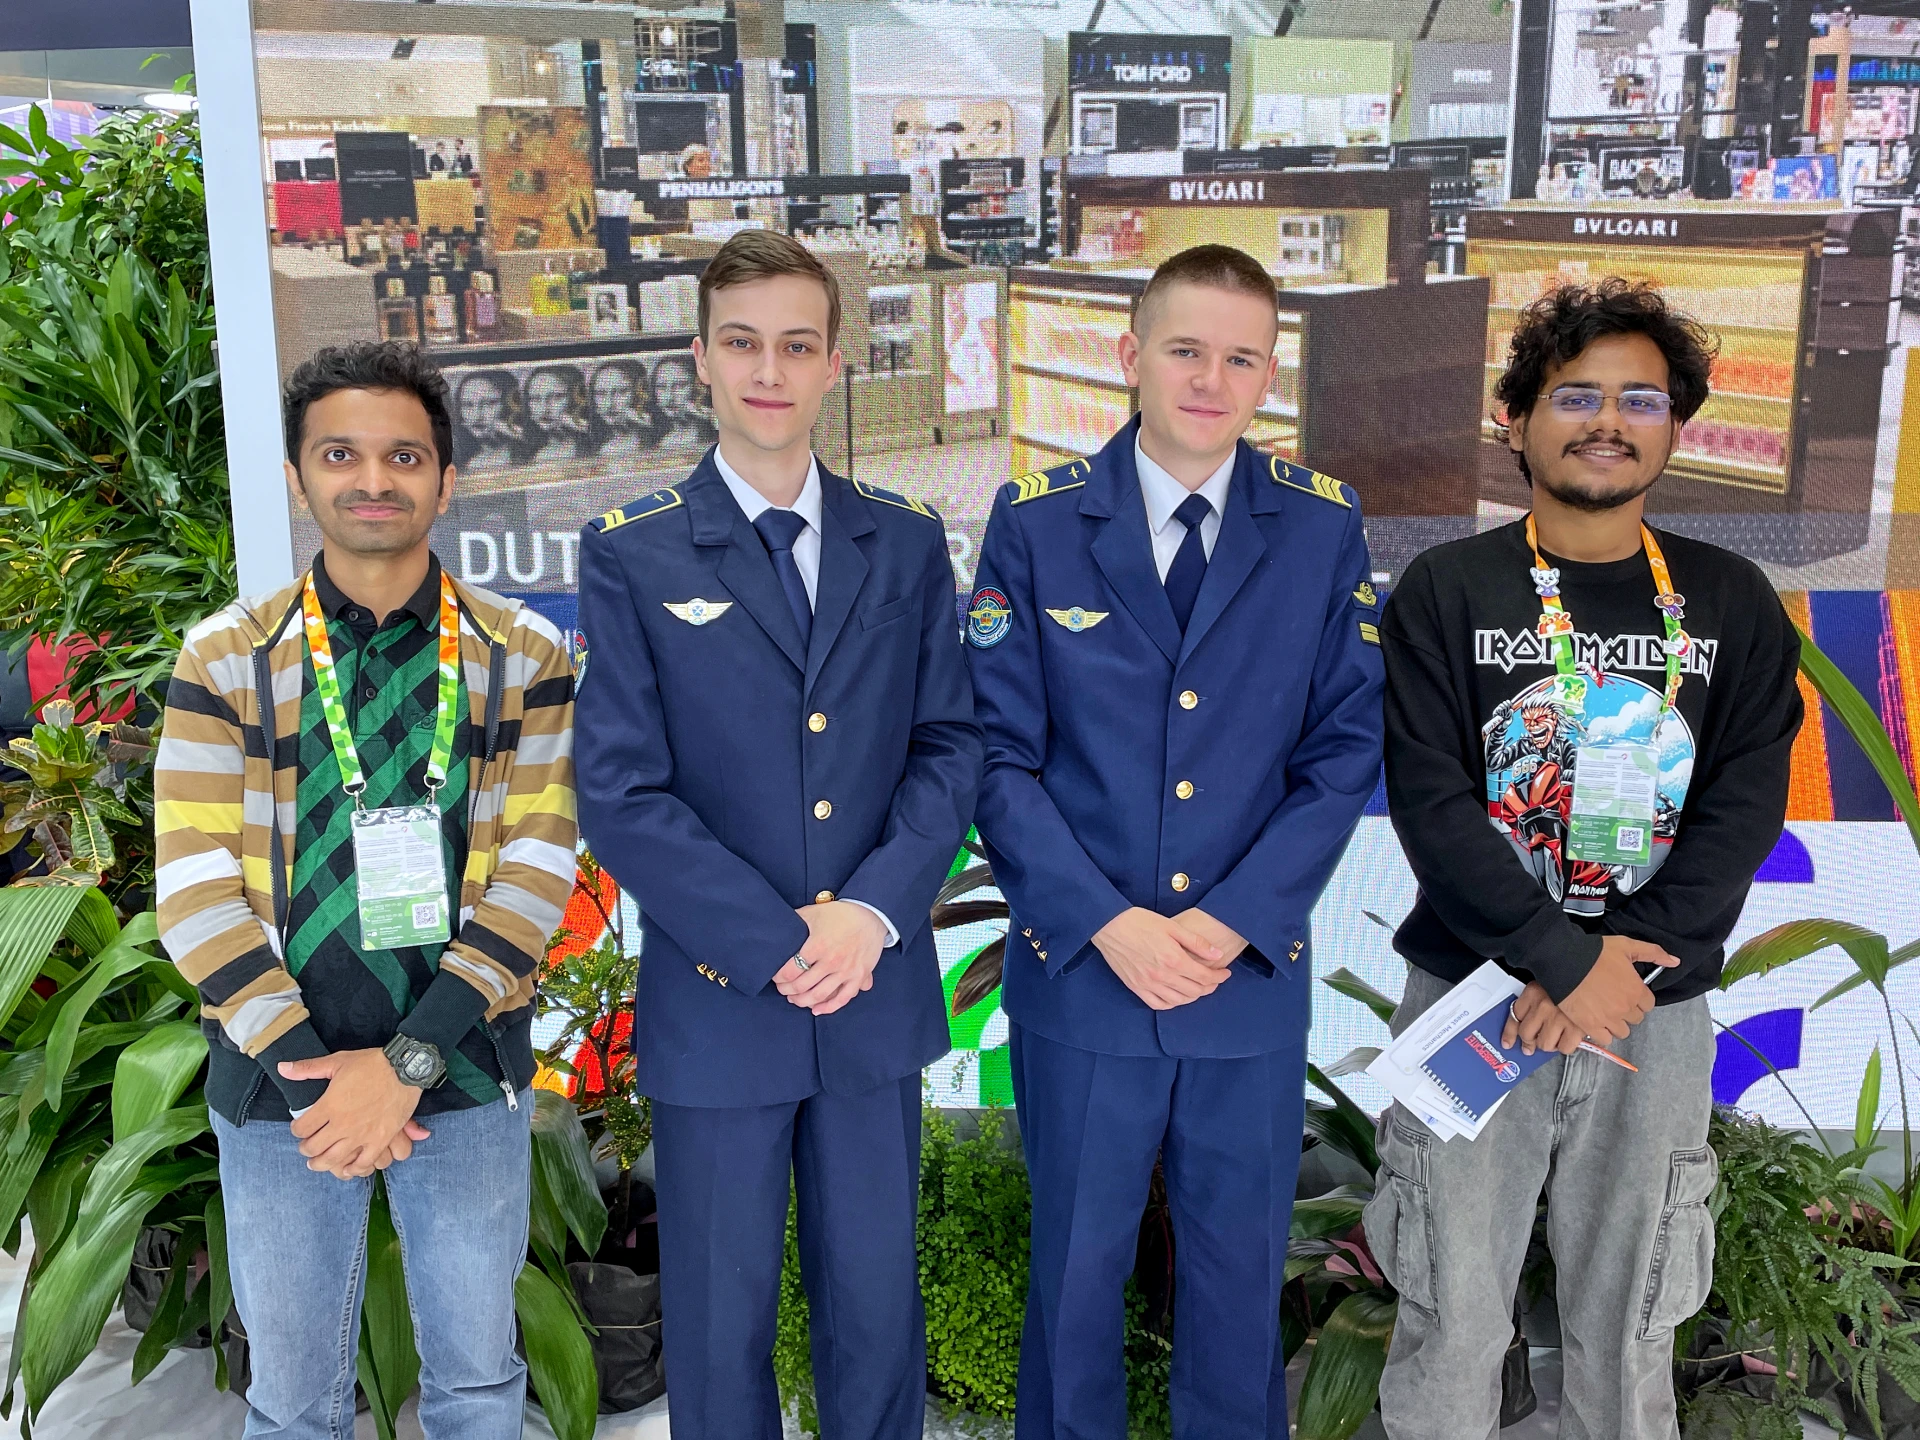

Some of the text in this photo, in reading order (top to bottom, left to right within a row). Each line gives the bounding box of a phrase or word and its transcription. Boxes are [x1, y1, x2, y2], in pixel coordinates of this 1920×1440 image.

[1112, 65, 1192, 82] TOM FORD
[1169, 181, 1264, 200] BVLGARI
[1573, 217, 1678, 237] BVLGARI
[459, 531, 580, 584] DUT
[1512, 757, 1539, 779] 666
[1569, 883, 1590, 896] IRON
[1450, 1010, 1470, 1026] Quest
[1421, 1024, 1453, 1052] Mechanics
